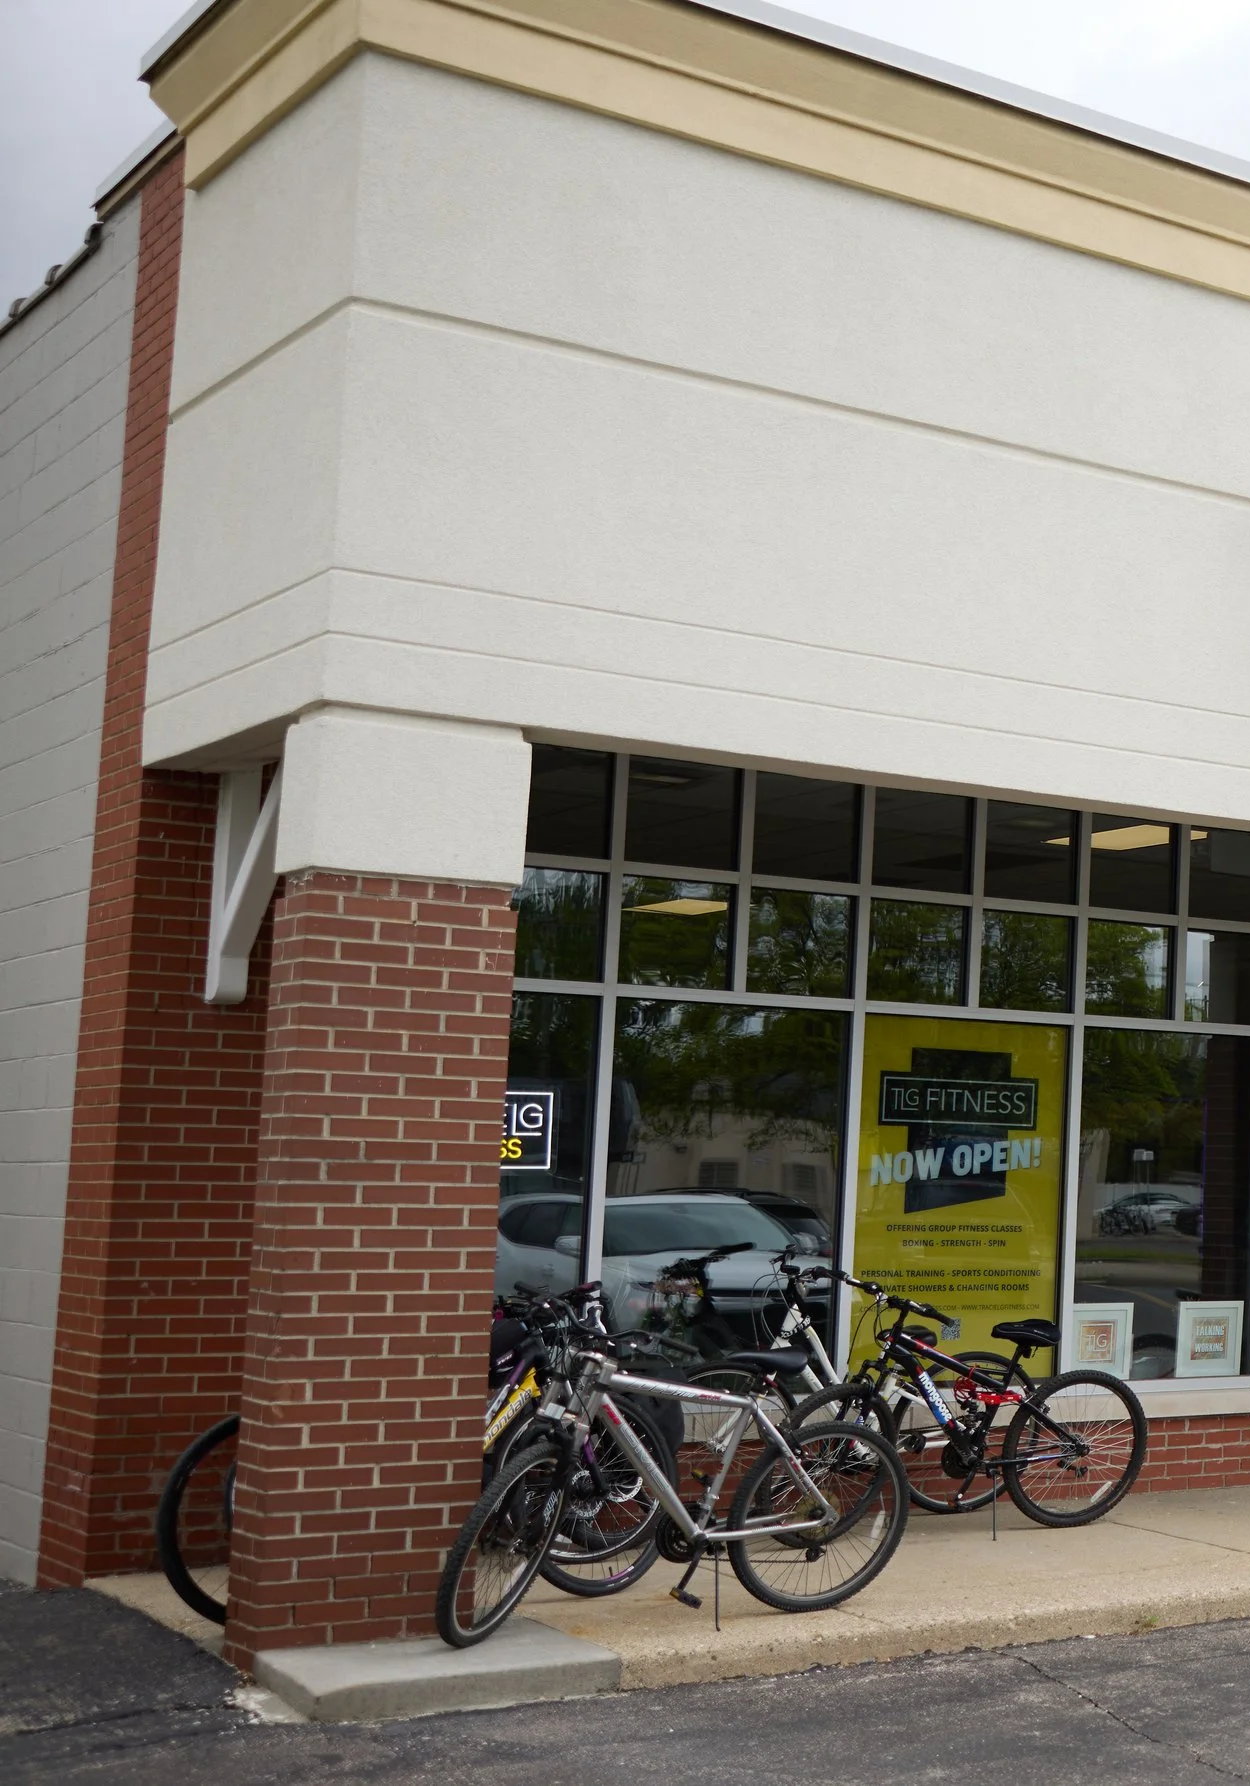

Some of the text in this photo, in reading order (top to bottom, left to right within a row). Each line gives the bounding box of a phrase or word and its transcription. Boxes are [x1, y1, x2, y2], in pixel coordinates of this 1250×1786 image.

[890, 1087, 1026, 1115] TLG FITNESS
[503, 1103, 543, 1136] LG
[870, 1137, 1042, 1186] NOW OPEN!
[886, 1224, 1023, 1233] OFFERING GROUP FITNESS CLASSES
[902, 1239, 934, 1247] BOXING
[941, 1239, 981, 1247] STRENGTH
[988, 1239, 1006, 1247] SPIN
[861, 1270, 903, 1278] PERSONAL
[906, 1269, 945, 1278] TRAINING
[952, 1269, 981, 1277] SPORTS
[983, 1269, 1041, 1277] CONDITIONING
[908, 1284, 947, 1292] SHOWERS
[948, 1284, 955, 1292] &
[956, 1283, 999, 1292] CHANGING
[1001, 1283, 1030, 1291] ROOMS
[1195, 1325, 1225, 1336] TALKING
[1194, 1342, 1224, 1353] WORKING
[918, 1372, 953, 1422] mongoose
